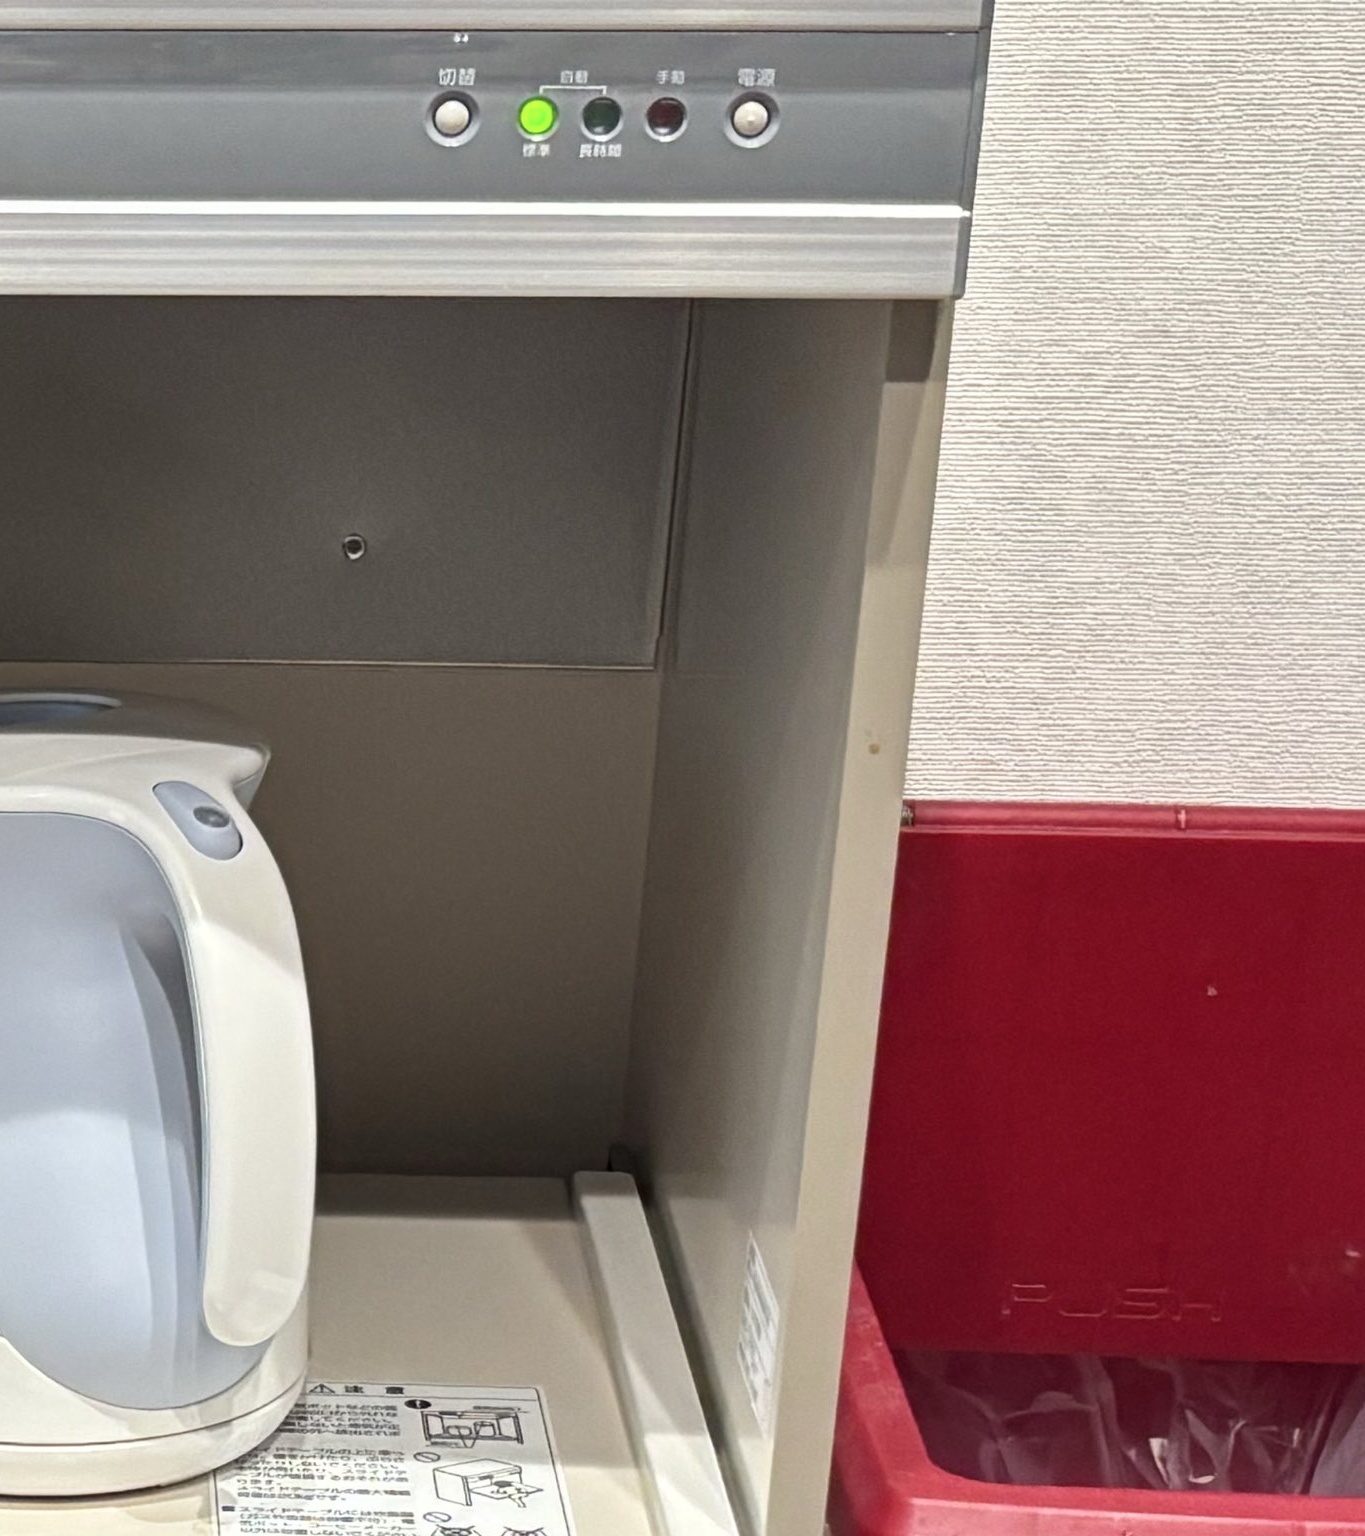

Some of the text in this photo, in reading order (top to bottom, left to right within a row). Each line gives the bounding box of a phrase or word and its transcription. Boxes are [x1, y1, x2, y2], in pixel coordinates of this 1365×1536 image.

[438, 67, 476, 86] 切替
[655, 69, 686, 85] 手動
[737, 67, 776, 87] 電源
[1000, 1281, 1222, 1323] PUSH
